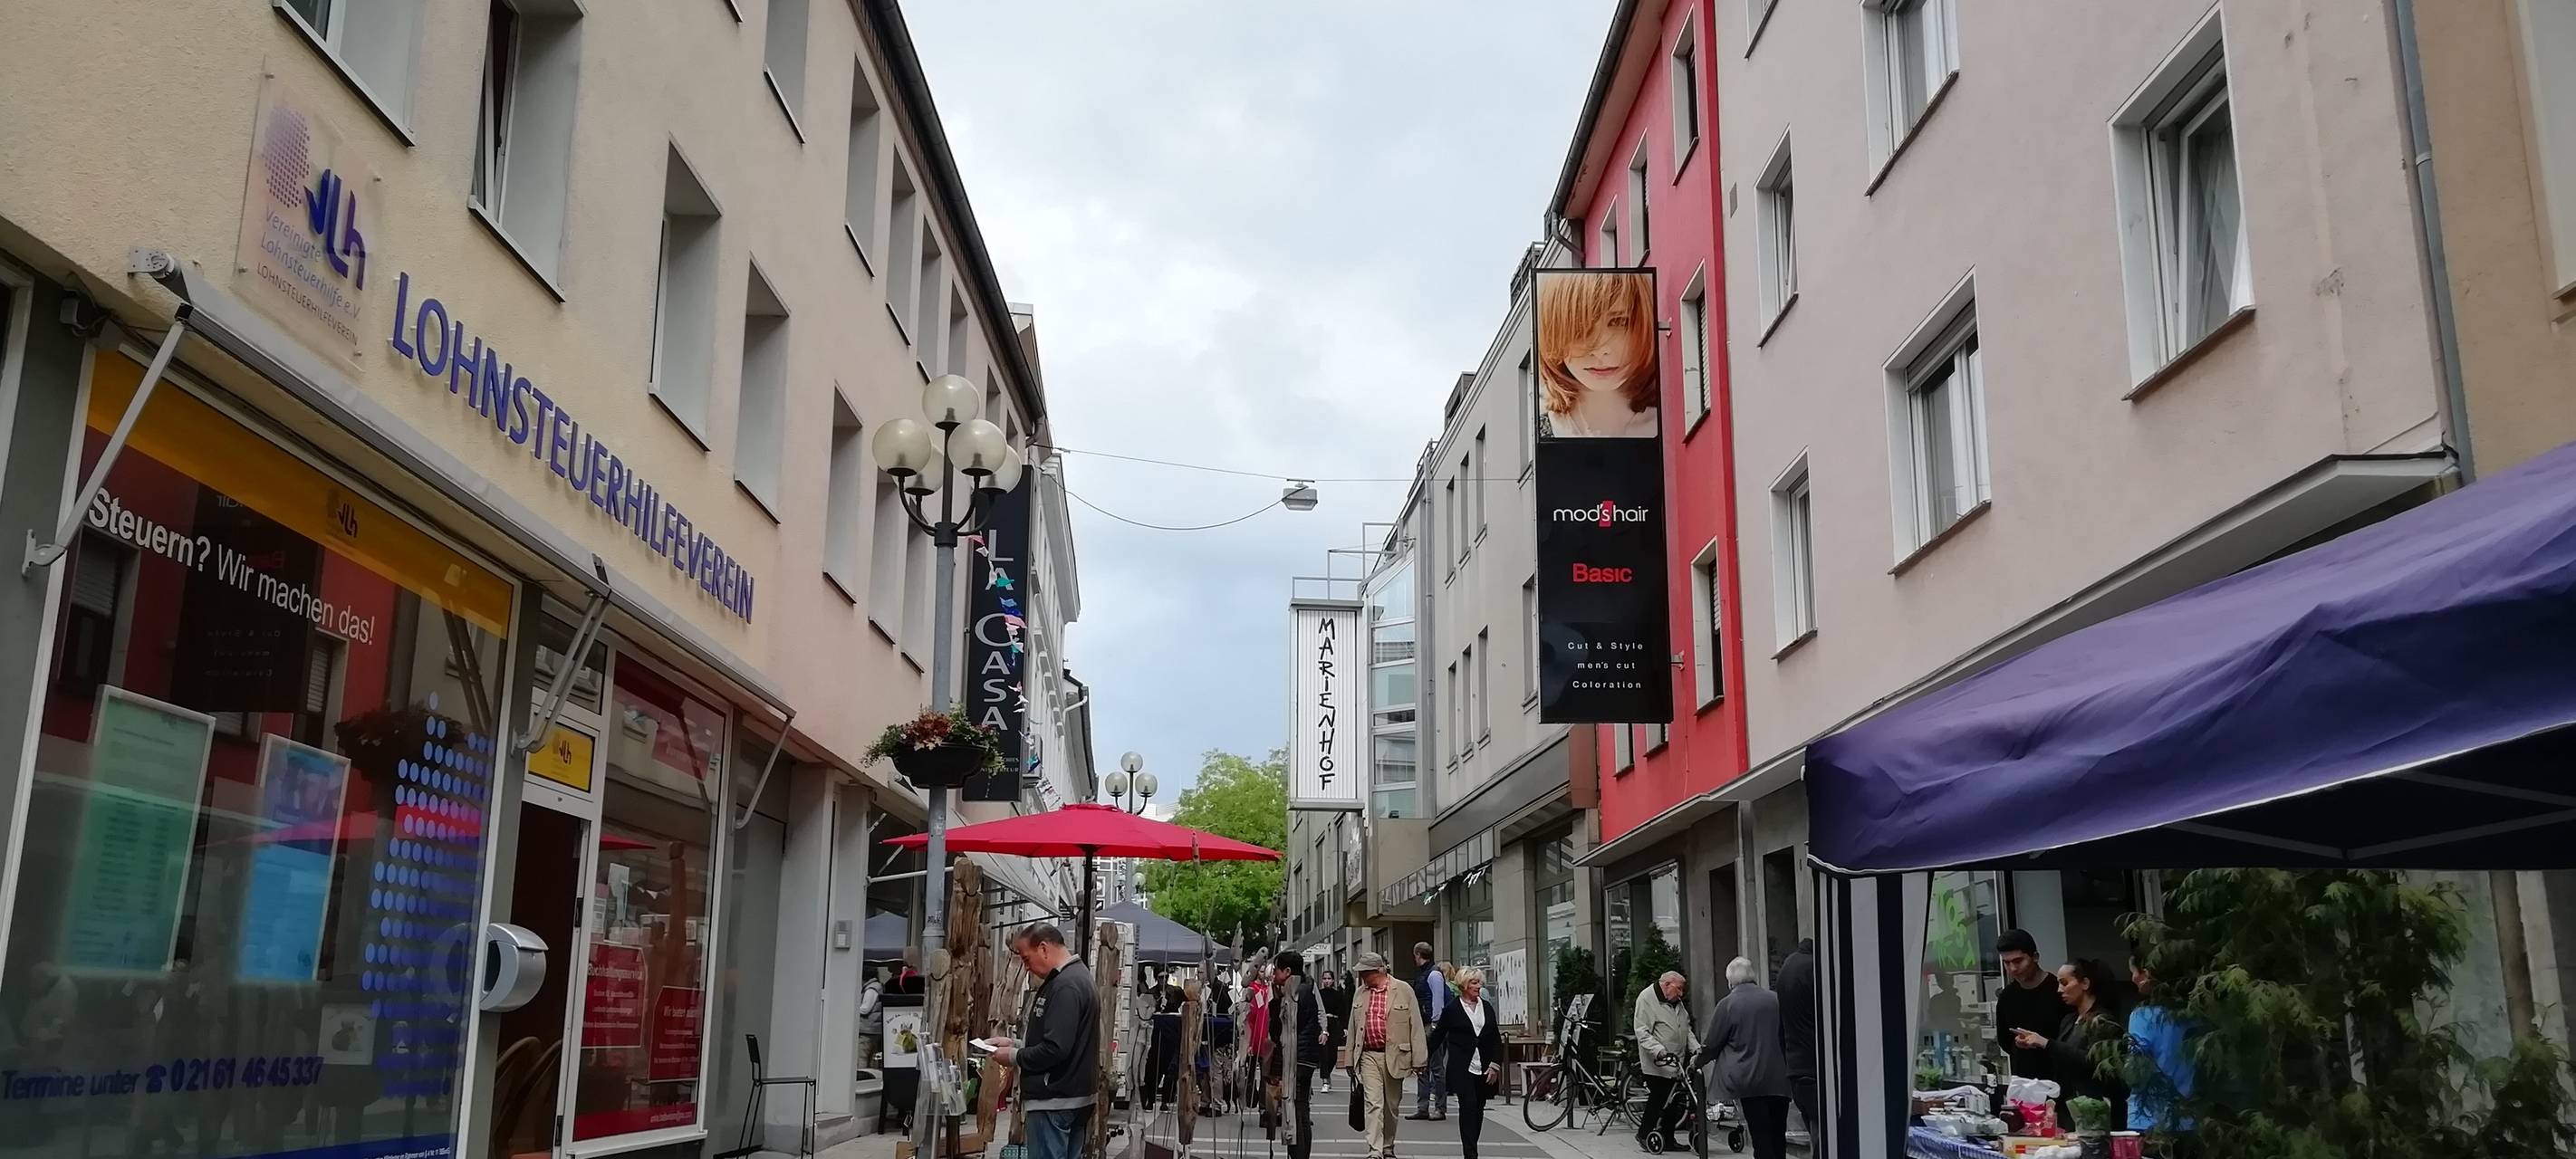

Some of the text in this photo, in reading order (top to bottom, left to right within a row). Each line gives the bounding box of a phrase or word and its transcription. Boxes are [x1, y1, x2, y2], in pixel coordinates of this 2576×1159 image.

[265, 206, 322, 263] Vereinigte
[260, 232, 342, 308] Lohnsteuerhilfe
[257, 262, 359, 346] LOHNSTEUERHILFEVEREIN
[392, 272, 755, 625] LOHNSTEUERHILFEVEREIN
[89, 487, 375, 646] Steuern? Wir machen das!
[985, 529, 1014, 590] LA
[1572, 563, 1632, 583] Basic
[975, 613, 1014, 731] CASA
[1567, 642, 1644, 652] Cut & Style
[1577, 661, 1636, 669] men's cut
[1572, 680, 1641, 689] Coloration
[1, 1068, 85, 1101] Termine
[91, 1068, 141, 1096] unter
